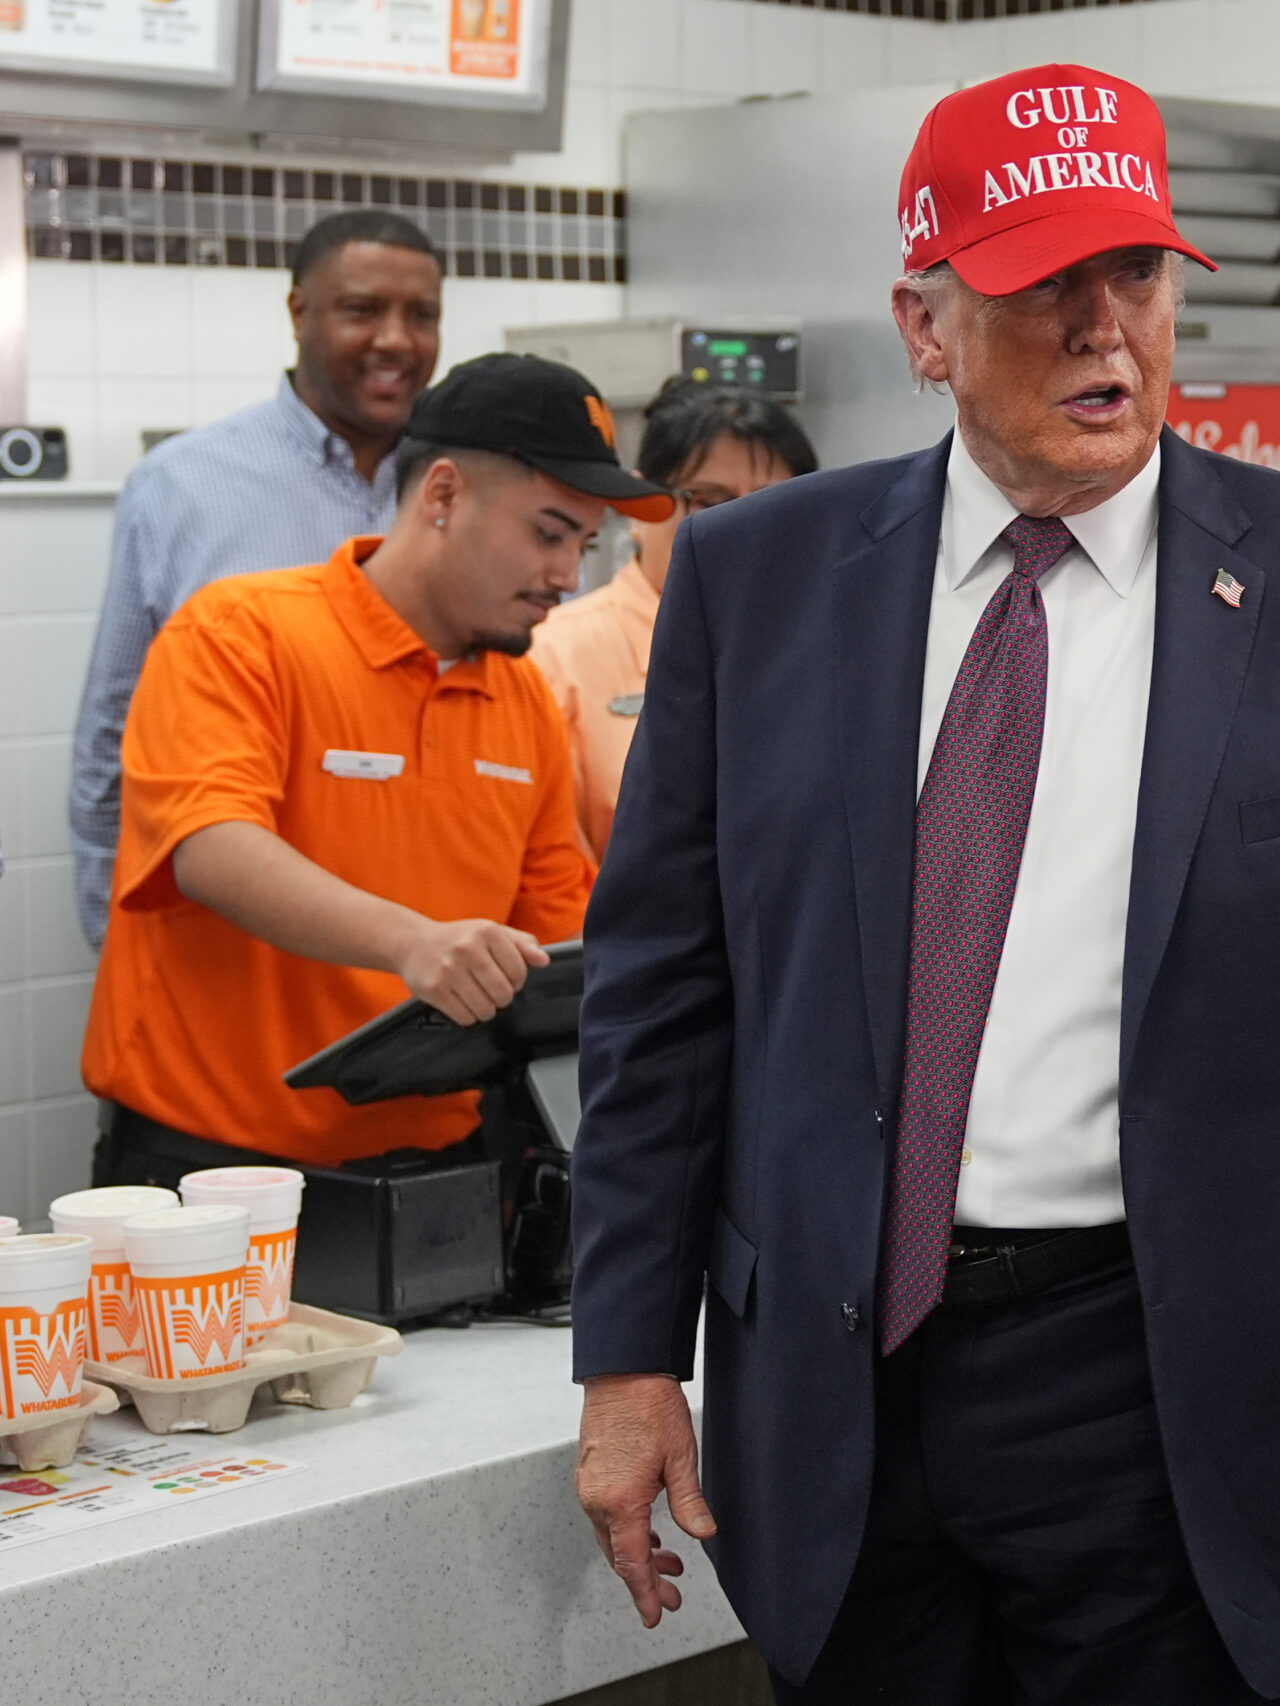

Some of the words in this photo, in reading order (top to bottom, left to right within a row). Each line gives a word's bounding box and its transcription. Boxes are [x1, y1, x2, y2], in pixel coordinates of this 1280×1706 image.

[1006, 86, 1118, 128] GULF
[1057, 126, 1088, 149] OF
[982, 151, 1159, 213] AMERICA
